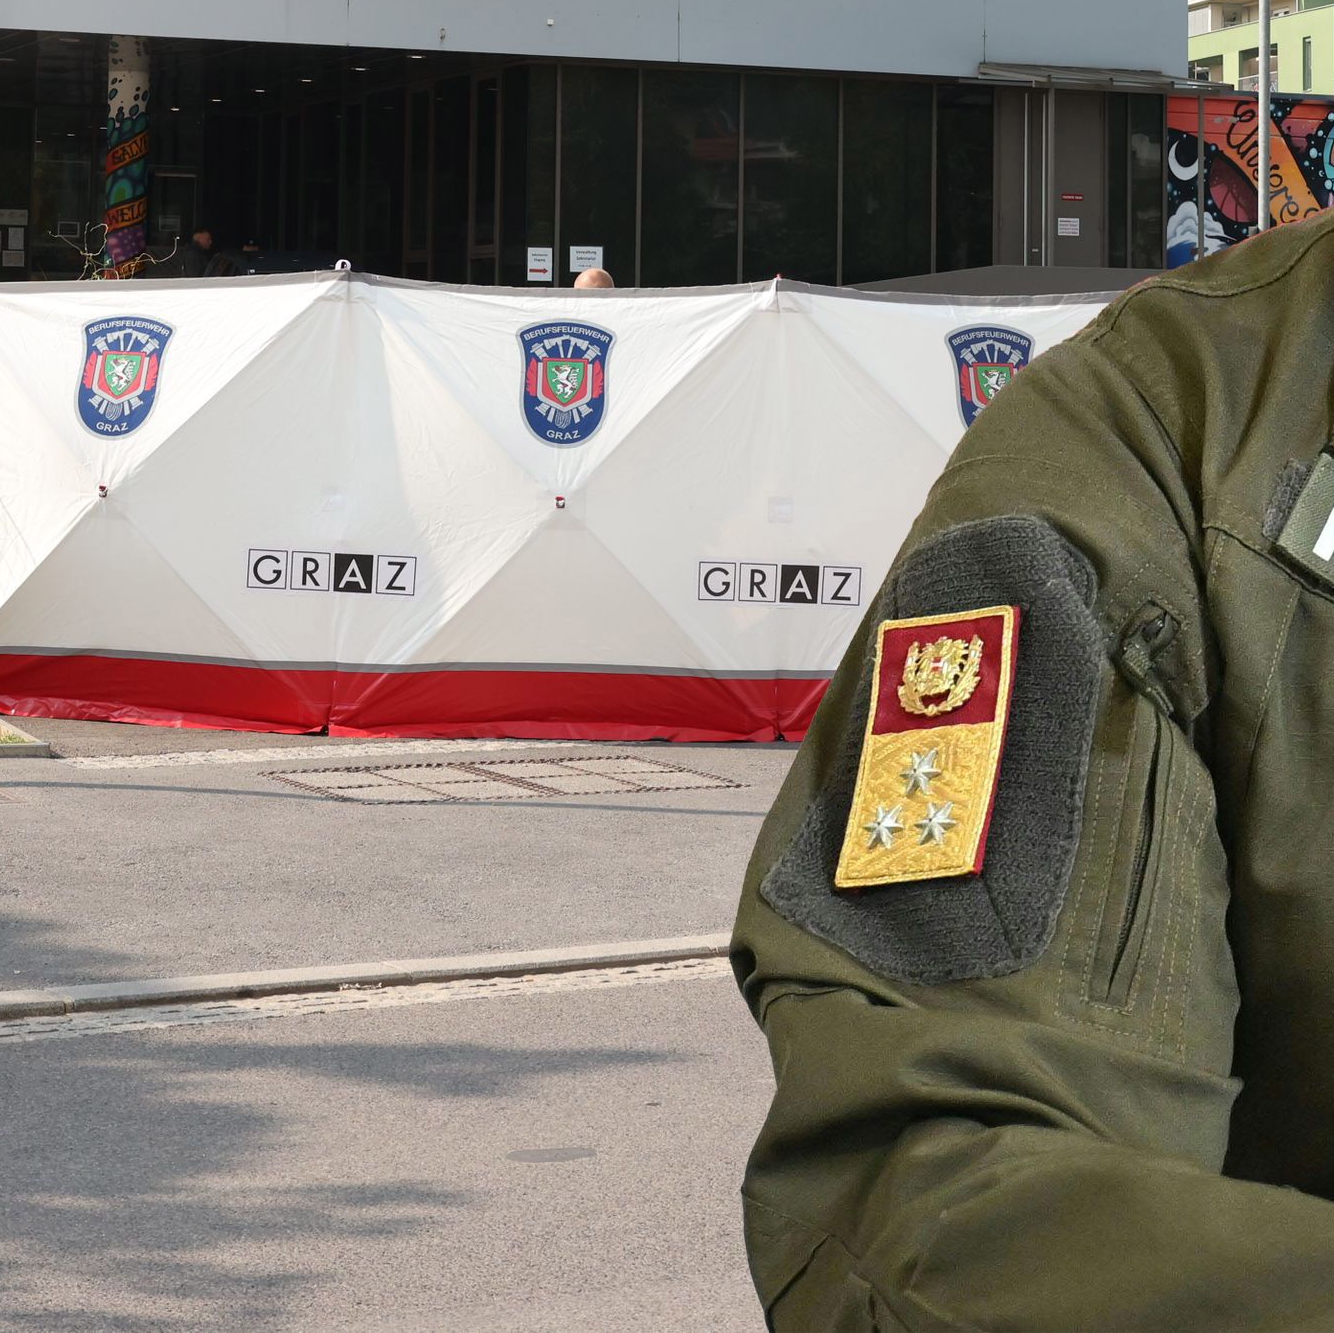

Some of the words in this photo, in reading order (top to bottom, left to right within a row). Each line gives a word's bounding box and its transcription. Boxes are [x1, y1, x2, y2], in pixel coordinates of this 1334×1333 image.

[88, 319, 170, 338] BERUFSFEUERWEHR
[523, 325, 611, 344] BERUFSFEUERWEHR
[951, 330, 1030, 348] BERUFSFEUERWEHR
[95, 421, 129, 432] GRAZ
[546, 429, 582, 441] GRAZ
[252, 554, 409, 592] GRAZ
[703, 567, 853, 602] GRAZ
